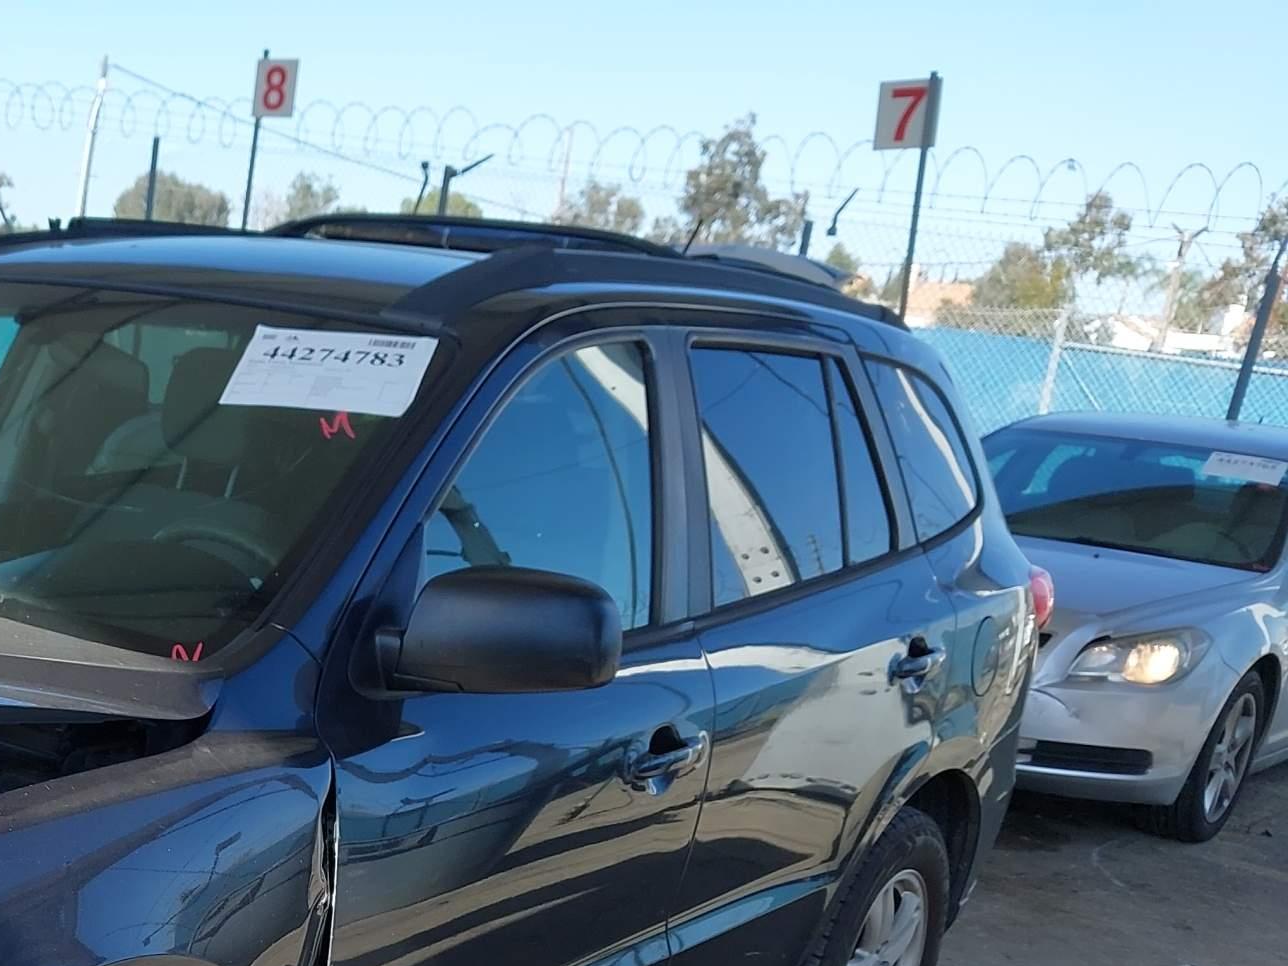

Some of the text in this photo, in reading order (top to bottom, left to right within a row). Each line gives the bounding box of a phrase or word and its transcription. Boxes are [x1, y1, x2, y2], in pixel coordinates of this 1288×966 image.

[263, 66, 286, 110] 8
[891, 86, 928, 142] 7
[263, 345, 406, 368] 44274783
